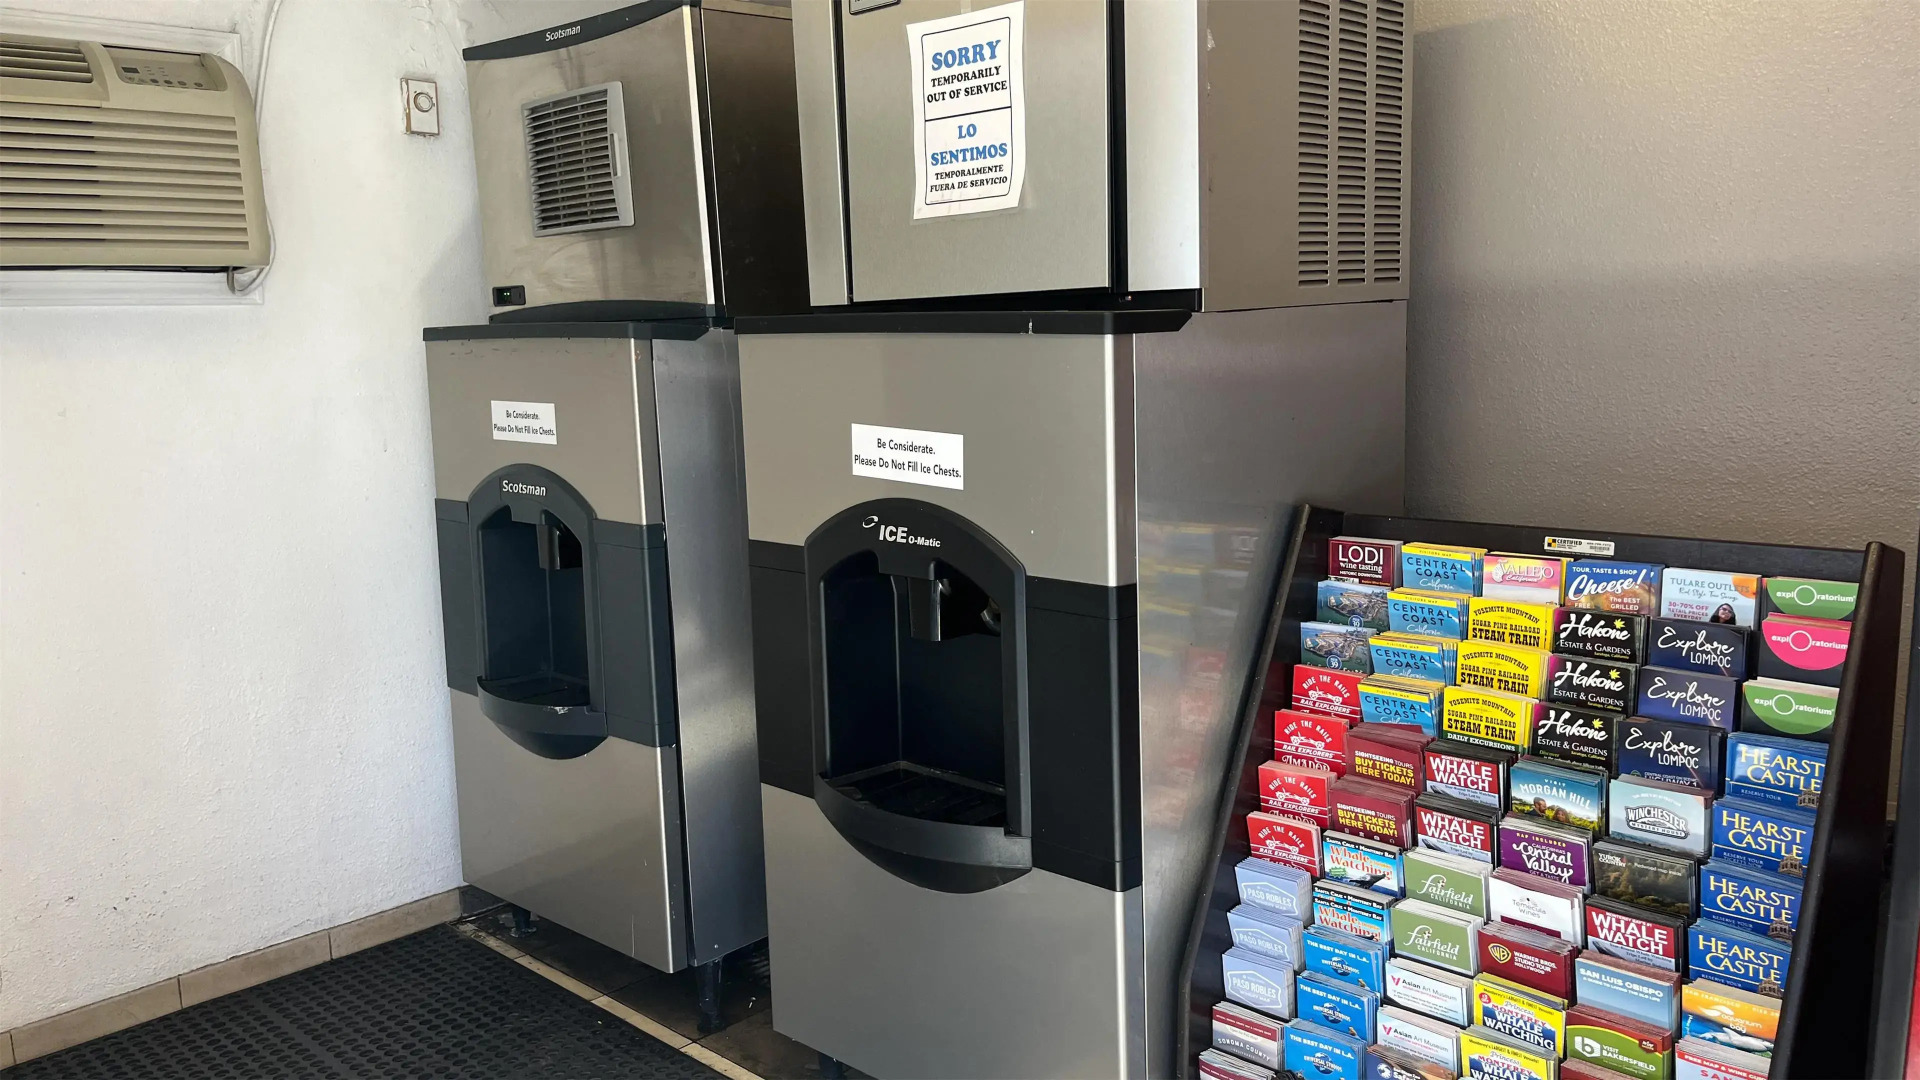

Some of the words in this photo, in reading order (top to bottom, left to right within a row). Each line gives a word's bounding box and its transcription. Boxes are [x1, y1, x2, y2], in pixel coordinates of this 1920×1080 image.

[546, 25, 581, 41] Scotsman
[932, 40, 1001, 71] SORRY
[931, 66, 1001, 87] TEMPORARILY
[927, 91, 946, 104] OUT
[949, 88, 961, 100] OF
[965, 80, 1008, 97] SERVICE
[958, 123, 977, 139] LO
[931, 143, 1008, 166] SENTIMOS
[935, 164, 1004, 180] TEMPORALMENTE
[930, 183, 956, 193] FUERA
[957, 181, 968, 189] DE
[970, 176, 1008, 188] SERVICIO
[506, 410, 512, 418] Be
[512, 410, 540, 420] Considerate.
[494, 423, 507, 432] Please
[508, 425, 514, 433] Do
[515, 425, 524, 434] Not
[539, 427, 555, 436] Chests.
[877, 438, 886, 449] Be
[888, 439, 935, 455] Considerate.
[854, 454, 876, 467] Please
[879, 457, 889, 469] Do
[891, 459, 905, 471] Not
[907, 461, 918, 472] Fill
[920, 463, 931, 474] Ice
[933, 464, 961, 478] Chests.
[502, 480, 546, 496] Scotsman
[879, 524, 908, 543] ICE
[1338, 544, 1384, 565] LODI
[1407, 557, 1465, 572] CENTRAL
[1358, 564, 1383, 574] tasting
[1416, 567, 1457, 580] COAST
[1501, 561, 1554, 580] VALLEJO
[1572, 567, 1591, 575] TOUR,
[1593, 567, 1612, 575] TASTE
[1568, 570, 1646, 602] Cheese!
[1670, 577, 1706, 589] TULARE
[1709, 581, 1750, 594] OUTLETS
[1393, 603, 1452, 618] CENTRAL
[1473, 606, 1504, 616] YOSEMITE
[1505, 606, 1540, 624] MOUNTAIN
[1610, 603, 1639, 611] GRILLED
[1402, 613, 1444, 626] COAST
[1472, 618, 1489, 627] SUGAR
[1490, 620, 1507, 630] PINE
[1508, 622, 1541, 635] RAILROAD
[1560, 613, 1631, 642] Hakone
[1472, 627, 1506, 644] STEAM
[1508, 633, 1540, 648] TRAIN
[1560, 639, 1584, 650] ESTATE
[1586, 642, 1593, 651] &
[1594, 643, 1631, 656] GARDENS
[1657, 627, 1735, 656] Explore
[1376, 649, 1435, 664] CENTRAL
[1386, 659, 1428, 671] COAST
[1690, 654, 1731, 668] LOMPOC
[1302, 676, 1315, 690] RIDE
[1319, 675, 1331, 683] THE
[1334, 678, 1351, 698] RAILS
[1461, 671, 1494, 687] STEAM
[1497, 679, 1529, 695] TRAIN
[1554, 659, 1625, 692] Hakone
[1553, 687, 1578, 699] ESTATE
[1579, 692, 1586, 700] &
[1588, 694, 1624, 707] GARDENS
[1647, 677, 1726, 707] Explore
[1300, 699, 1315, 708] RAIL
[1317, 702, 1352, 714] EXPLORERS
[1365, 696, 1425, 712] CENTRAL
[1375, 706, 1417, 720] COAST
[1680, 703, 1722, 721] LOMPOC
[1447, 721, 1482, 737] STEAM
[1484, 728, 1517, 742] TRAIN
[1537, 709, 1608, 742] Hakone
[1282, 744, 1297, 753] RAIL
[1298, 746, 1335, 759] EXPLORERS
[1447, 732, 1467, 742] DAILY
[1469, 735, 1516, 752] EXCURSIONS
[1625, 727, 1701, 758] Explore
[1355, 750, 1394, 764] SIGHTSEEING
[1395, 759, 1413, 769] TOURS
[1355, 756, 1372, 767] BUY
[1374, 760, 1414, 778] TICKETS
[1429, 756, 1492, 781] WHALE
[1658, 753, 1699, 769] LOMPOC
[1740, 746, 1825, 777] HEARST
[1355, 765, 1380, 777] HERE
[1382, 769, 1415, 787] TODAY!
[1434, 769, 1489, 792] WATCH
[1747, 765, 1821, 793] CASTLE
[1519, 783, 1566, 800] MORGAN
[1569, 796, 1591, 811] HILL
[1338, 809, 1354, 820] BUY
[1356, 812, 1396, 829] TICKETS
[1338, 817, 1363, 830] HERE
[1365, 821, 1398, 839] TODAY!
[1421, 811, 1485, 839] WHALE
[1627, 806, 1686, 831] WINCHESTER
[1722, 810, 1806, 843] HEARST
[1425, 824, 1481, 849] WATCH
[1728, 830, 1803, 860] CASTLE
[1330, 845, 1370, 863] Whale
[1512, 841, 1573, 866] Central
[1330, 855, 1393, 881] Watching!
[1522, 853, 1574, 884] Valley
[1415, 874, 1473, 905] fairfield
[1709, 875, 1795, 908] HEARST
[1430, 893, 1471, 910] CALIFORNIA
[1716, 894, 1793, 924] CASTLE
[1591, 912, 1667, 945] WHALE
[1598, 925, 1663, 954] WATCH
[1514, 950, 1539, 963] WARNER
[1540, 957, 1557, 970] BROS.
[1698, 934, 1783, 968] HEARST
[1706, 952, 1782, 984] CASTLE
[1232, 977, 1249, 990] PASO
[1251, 981, 1277, 998] ROBLES
[1402, 978, 1421, 989] Asian
[1422, 984, 1432, 992] Art
[1433, 987, 1457, 1001] Museum
[1579, 968, 1600, 979] SAN
[1602, 975, 1624, 987] LUIS
[1625, 981, 1664, 998] OBISPO
[1491, 1003, 1547, 1027] MONTEREY
[1495, 1011, 1543, 1037] WHALE
[1483, 1016, 1555, 1051] WATCHING
[1217, 1037, 1244, 1048] SONOMA
[1246, 1044, 1271, 1062] COUNTY
[1303, 1037, 1318, 1047] BEST
[1319, 1042, 1333, 1051] DAY
[1342, 1050, 1354, 1060] L.A.
[1602, 1044, 1619, 1054] VISIT
[1602, 1050, 1656, 1072] BAKERSFIELD
